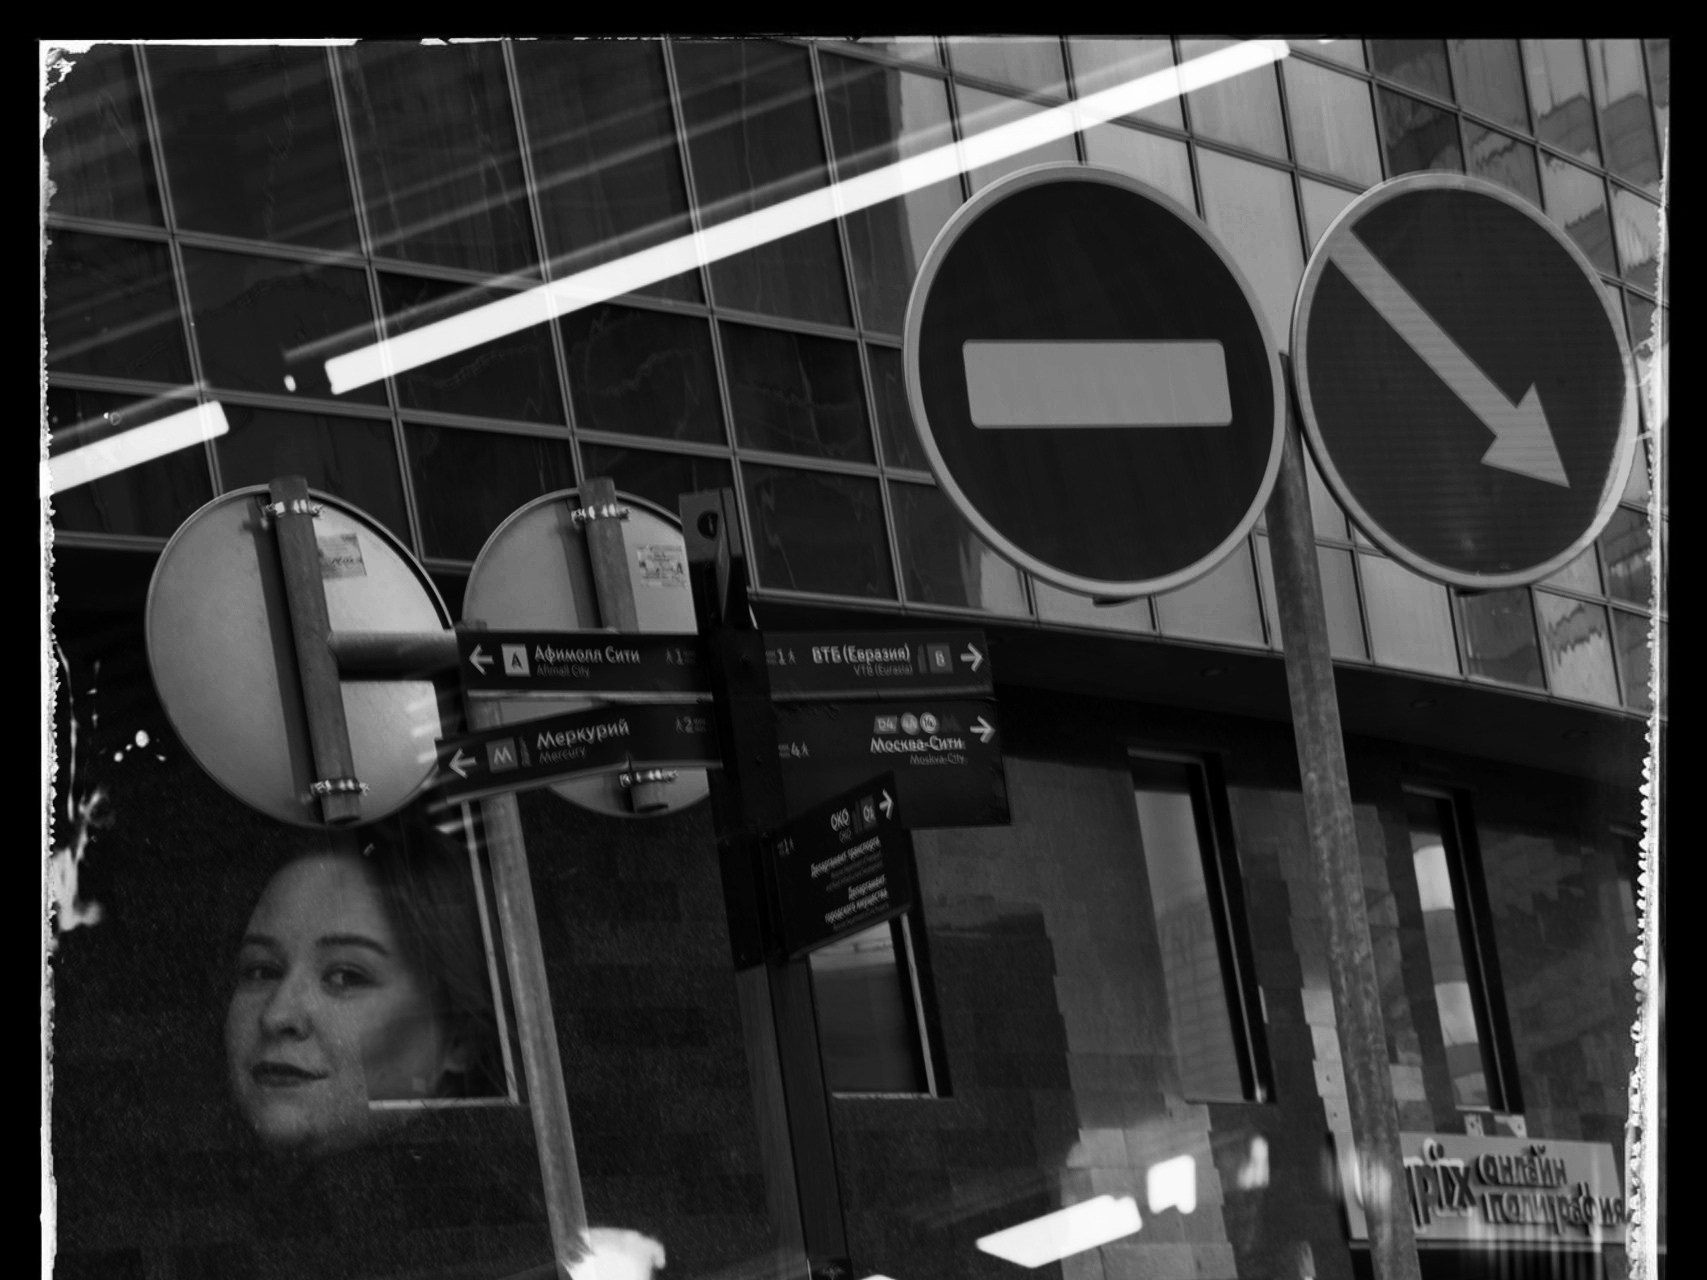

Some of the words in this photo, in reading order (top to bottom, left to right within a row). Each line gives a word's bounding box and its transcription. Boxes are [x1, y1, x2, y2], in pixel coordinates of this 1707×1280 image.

[534, 643, 603, 665] Афимолл
[604, 644, 641, 665] Сити
[811, 645, 842, 665] ВТБ
[843, 642, 911, 665] (Евразия)
[571, 665, 591, 680] City
[536, 717, 630, 751] Меркурий
[870, 735, 965, 754] Москва-Сити
[538, 745, 587, 765] Mercury
[910, 752, 966, 766] Moskva-City
[1475, 1144, 1569, 1188] онлайн
